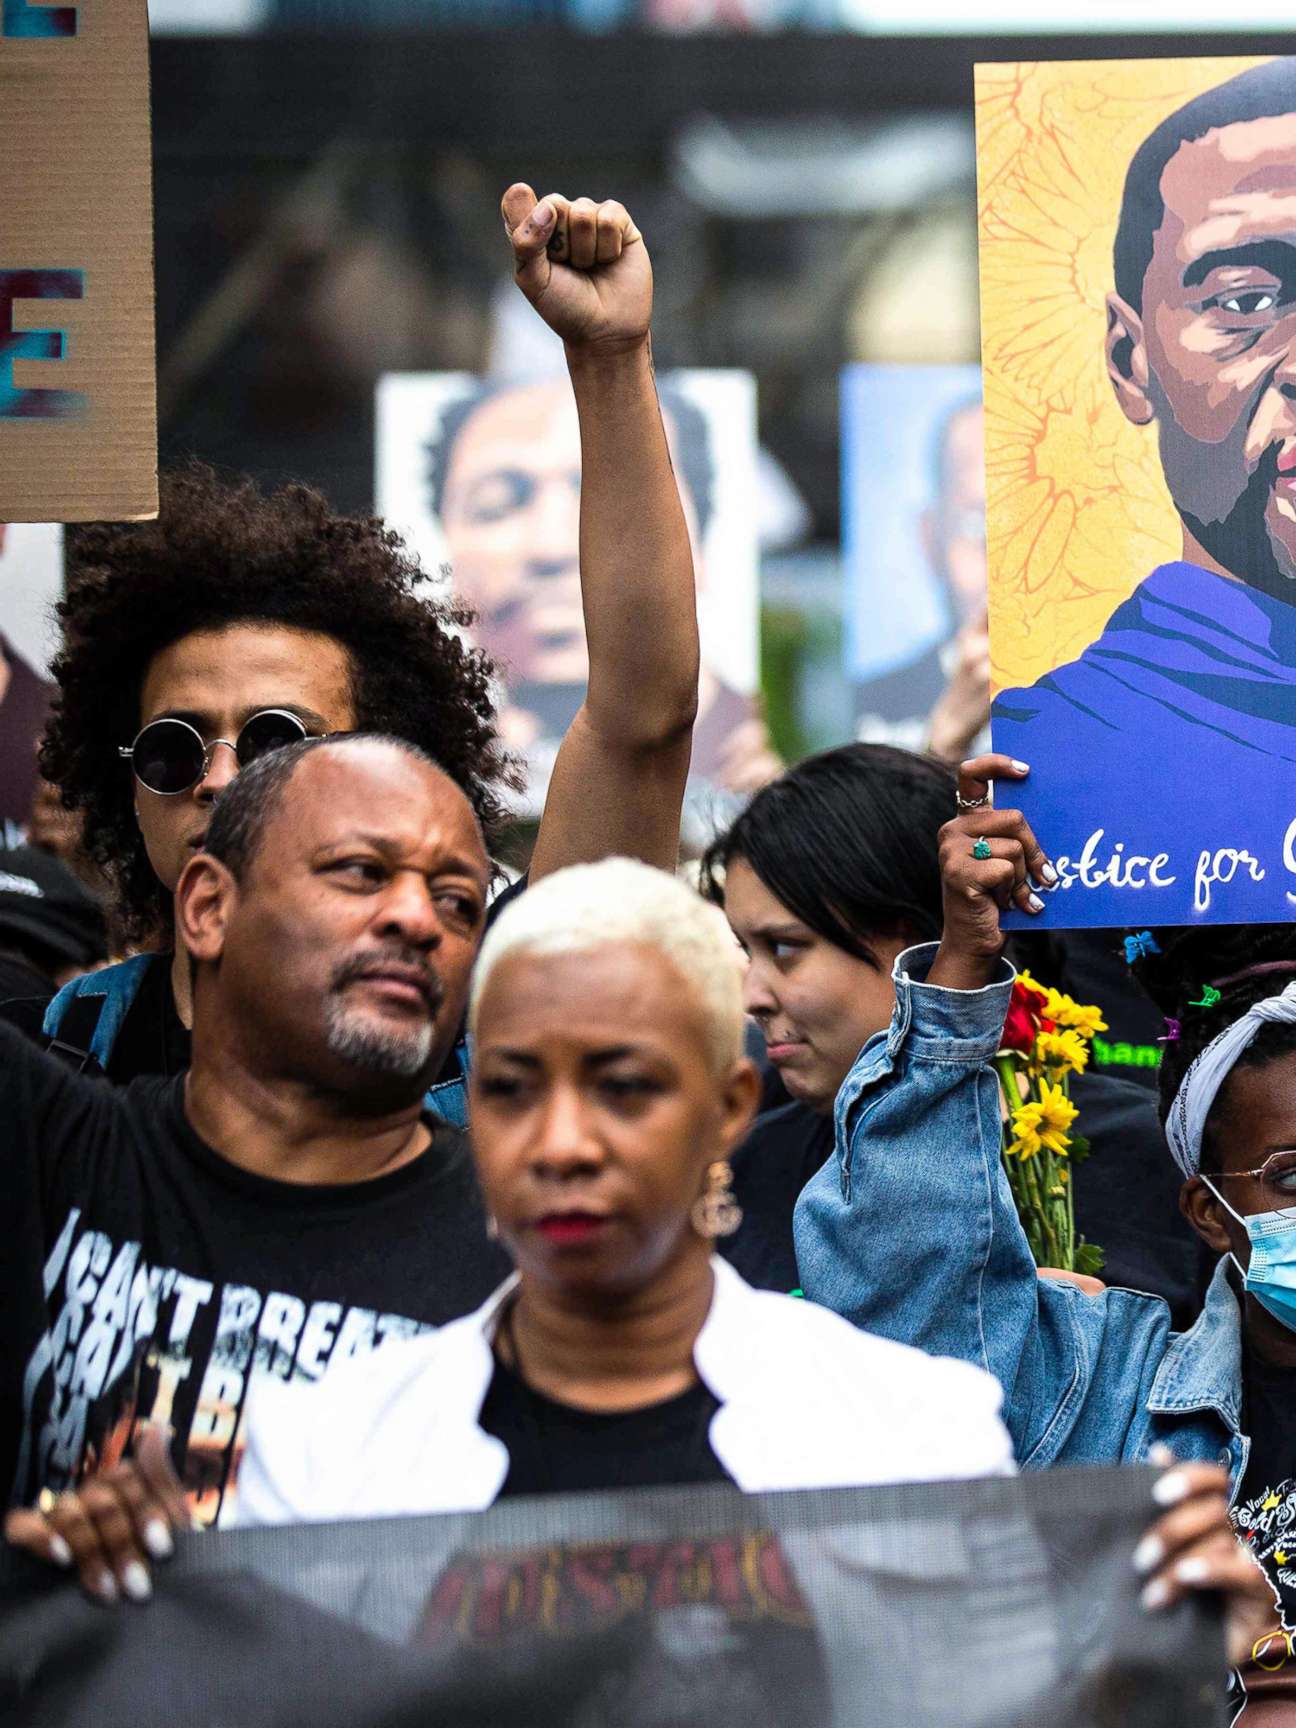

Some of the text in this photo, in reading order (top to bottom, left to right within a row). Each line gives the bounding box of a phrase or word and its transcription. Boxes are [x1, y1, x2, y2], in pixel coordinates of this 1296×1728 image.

[1025, 828, 1177, 893] stice
[1194, 847, 1265, 913] for
[214, 1282, 440, 1384] BREAT
